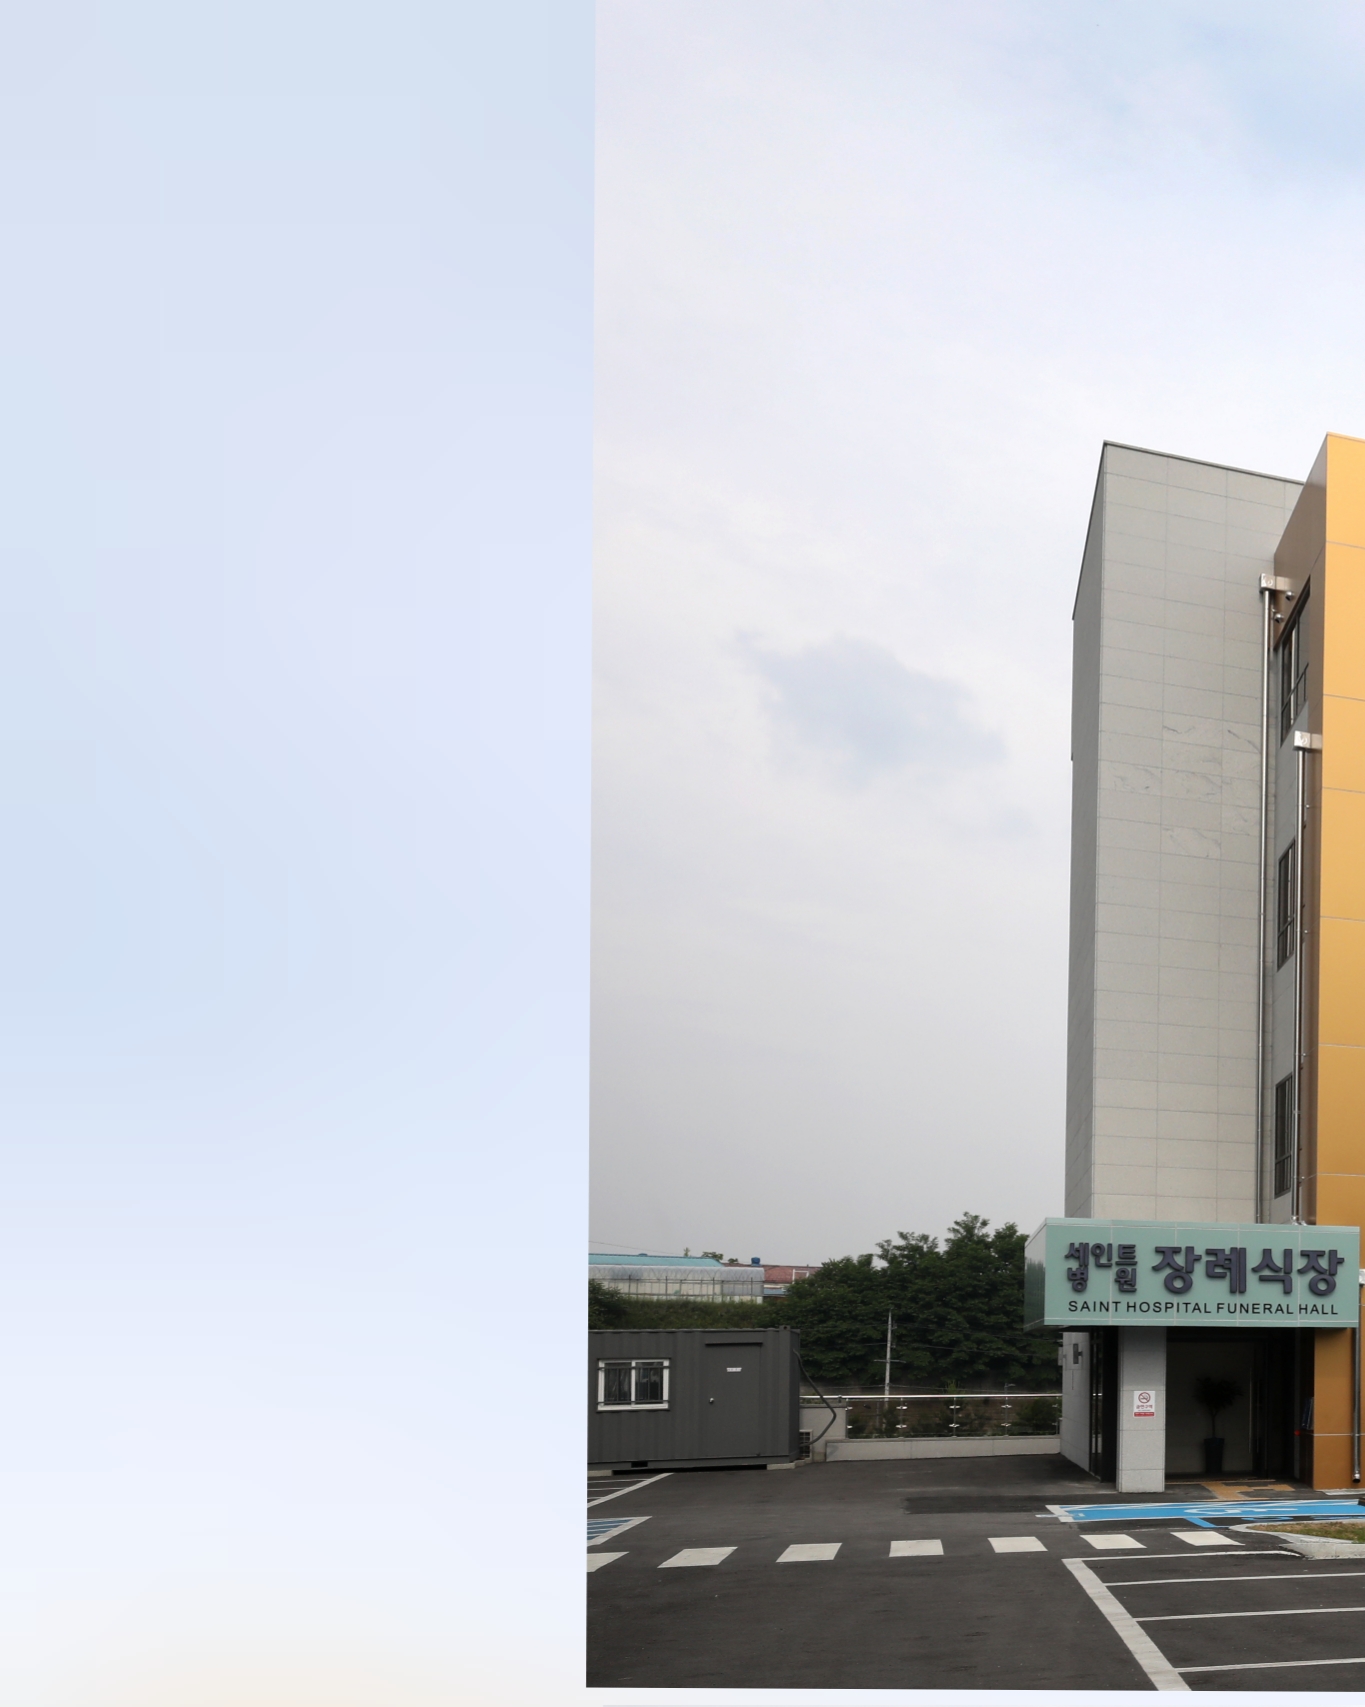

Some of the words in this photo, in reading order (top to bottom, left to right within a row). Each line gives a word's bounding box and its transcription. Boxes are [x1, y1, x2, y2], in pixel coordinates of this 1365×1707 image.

[1065, 1242, 1137, 1267] 세인트
[1152, 1246, 1344, 1295] 장례식장
[1068, 1301, 1121, 1312] SAINT
[1126, 1302, 1211, 1313] HOSPITAL
[1217, 1303, 1294, 1314] FUNERAL
[1299, 1303, 1338, 1315] HALL
